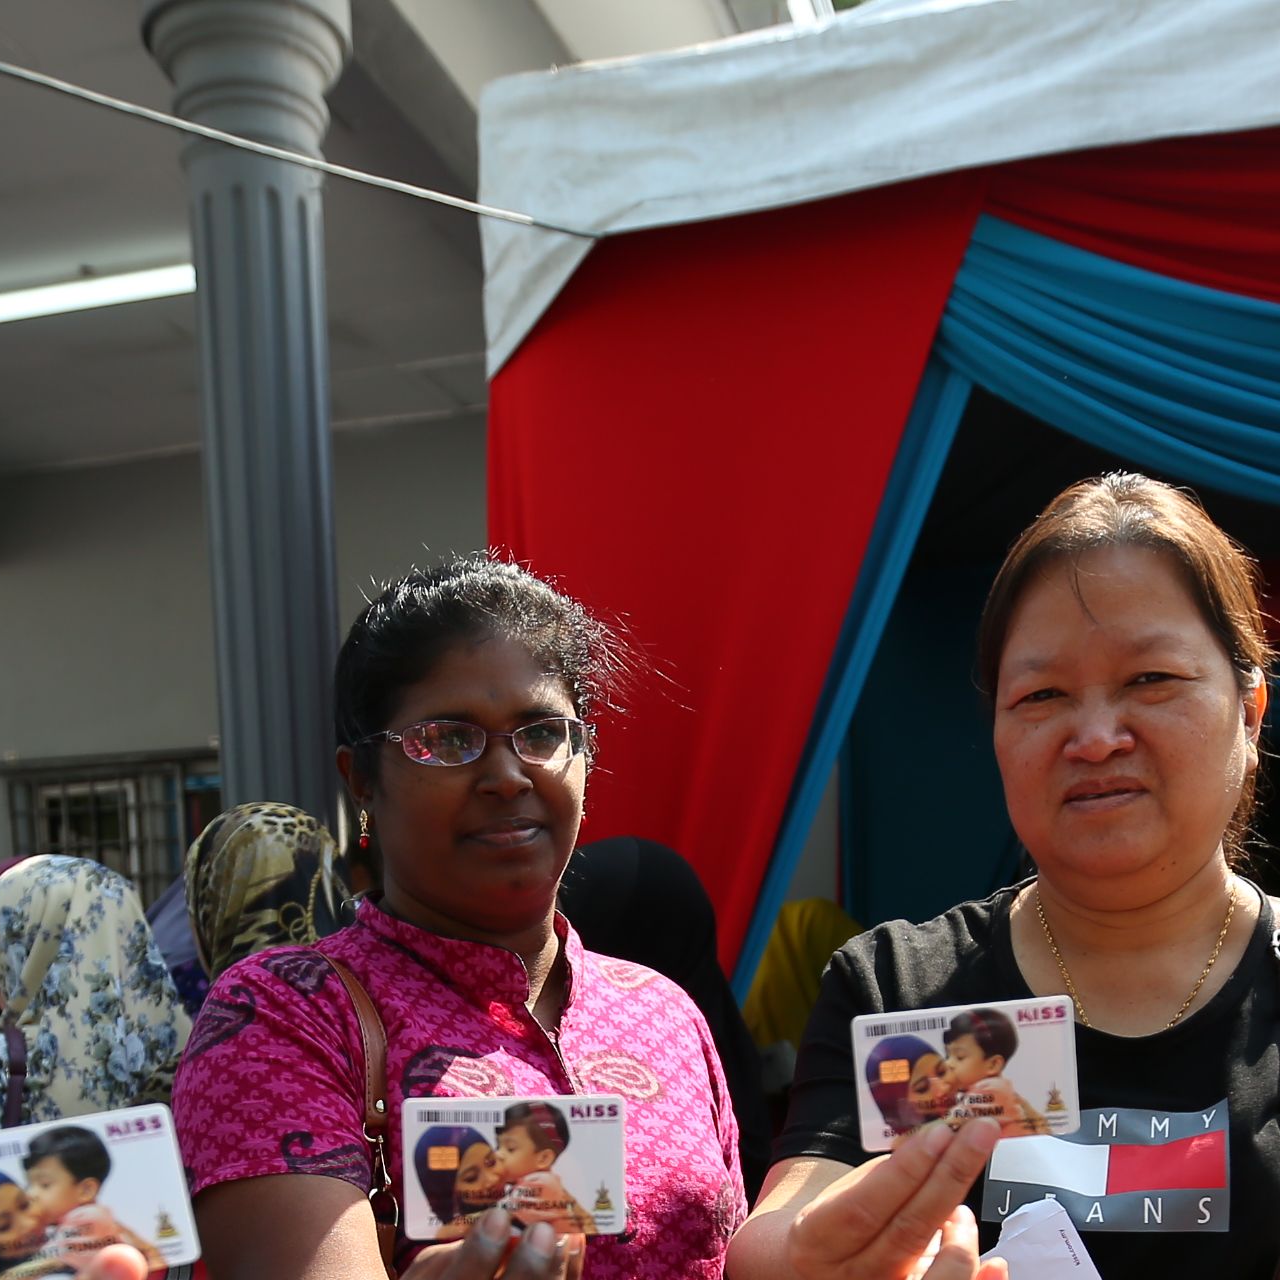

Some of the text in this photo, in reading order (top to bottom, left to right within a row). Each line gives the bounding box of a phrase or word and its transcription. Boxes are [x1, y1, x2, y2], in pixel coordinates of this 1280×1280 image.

[1016, 1005, 1067, 1023] KISS
[570, 1104, 619, 1119] KISS
[955, 1106, 1006, 1119] RATNAM
[106, 1115, 163, 1136] KISS
[1098, 1109, 1217, 1139] MMY
[998, 1189, 1212, 1225] JANS
